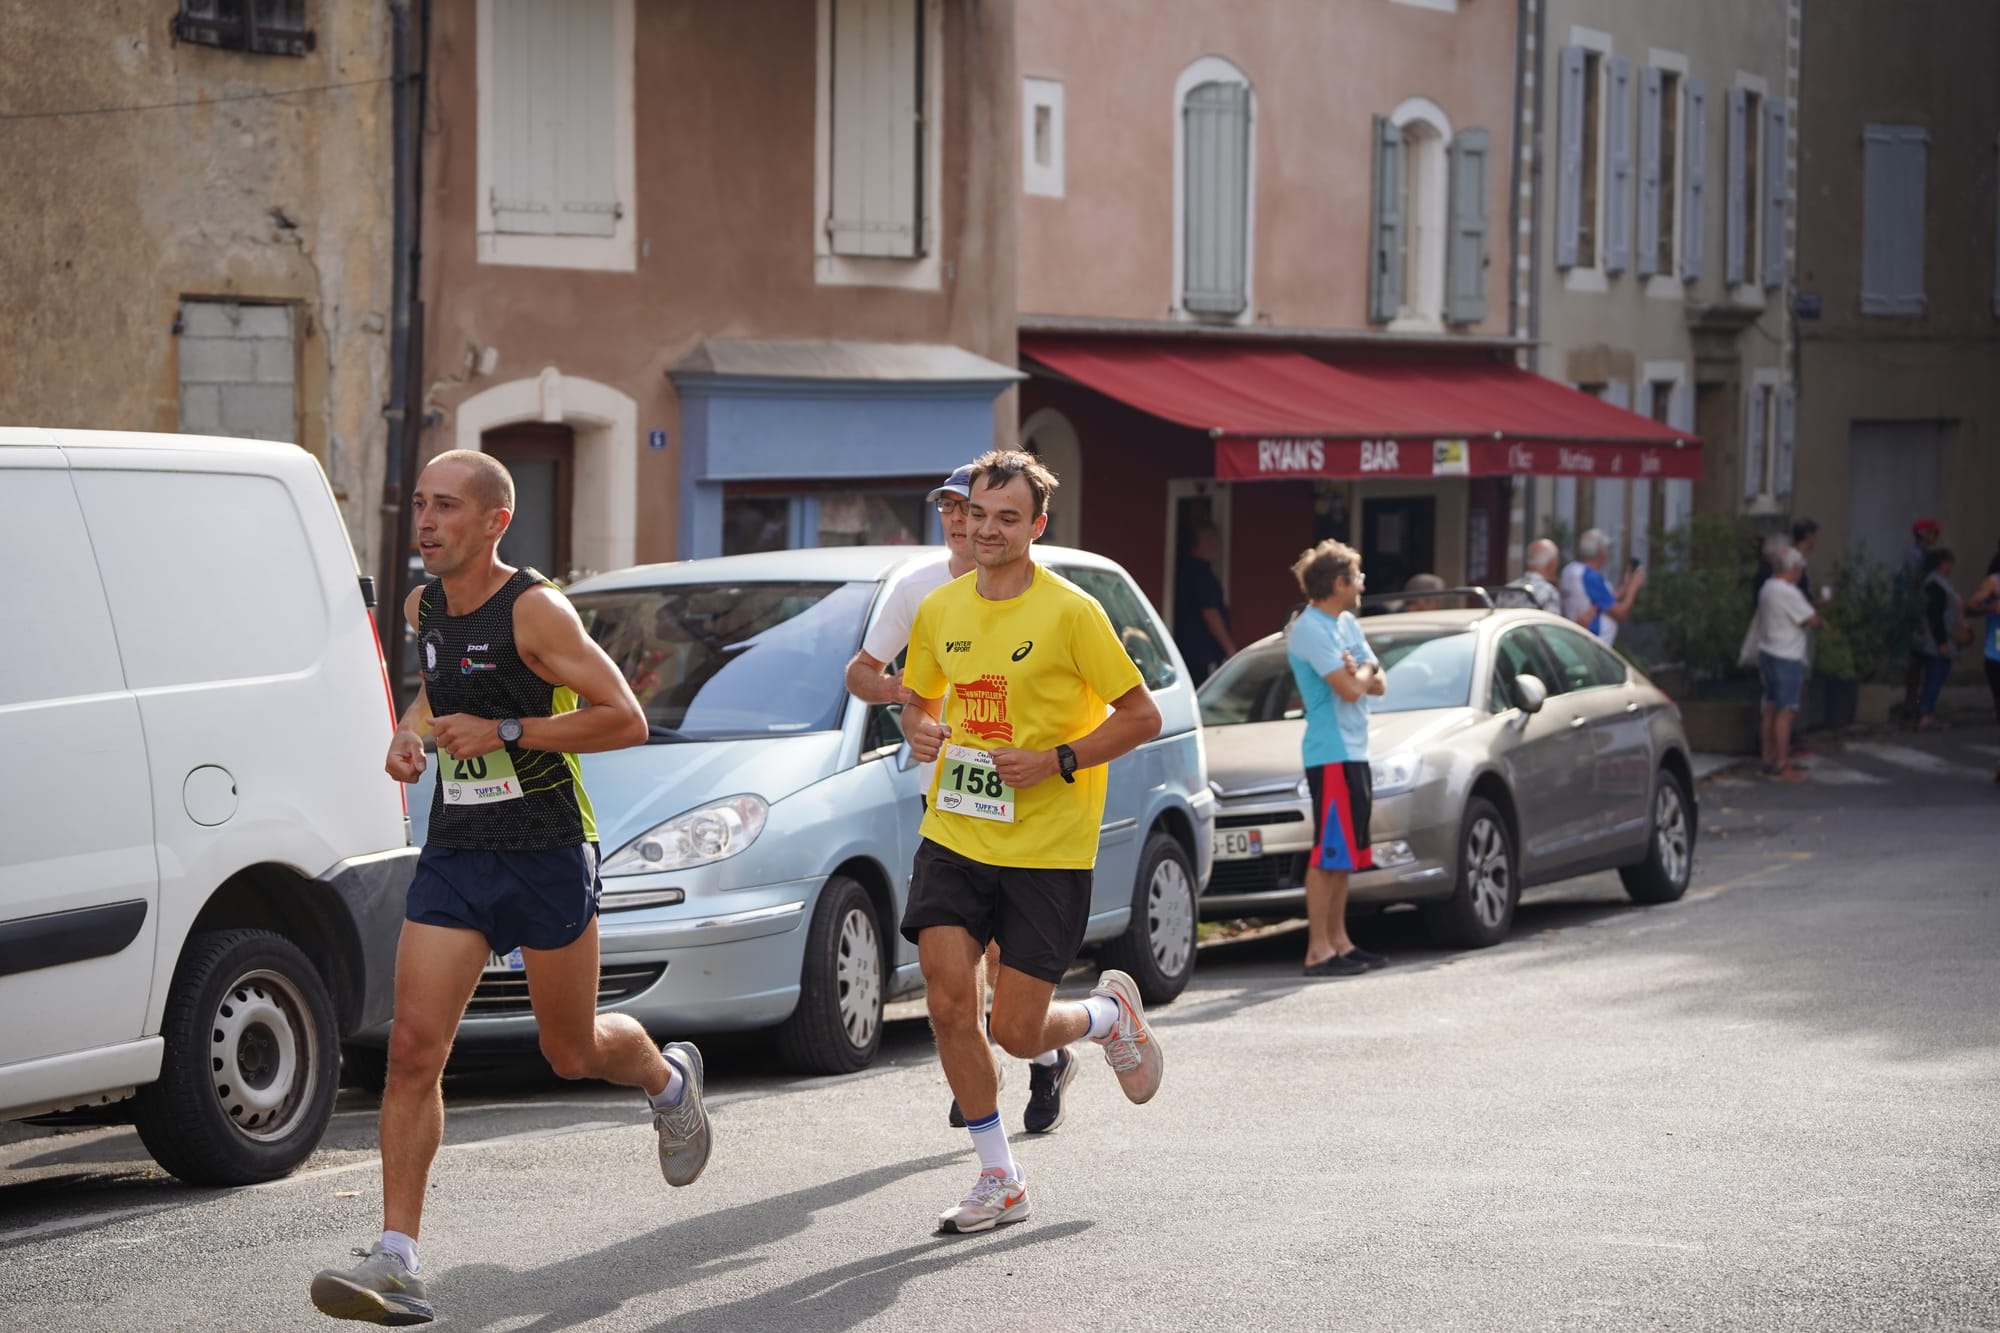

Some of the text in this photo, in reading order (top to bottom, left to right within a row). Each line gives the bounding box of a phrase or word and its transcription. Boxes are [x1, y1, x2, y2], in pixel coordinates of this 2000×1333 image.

[1258, 440, 1325, 471] RYAN'S
[1360, 441, 1399, 470] BAR
[967, 698, 999, 722] RUN
[450, 754, 487, 780] 20
[474, 786, 502, 794] TUFF'S
[952, 764, 1003, 798] 158
[974, 802, 999, 811] TUFF'S
